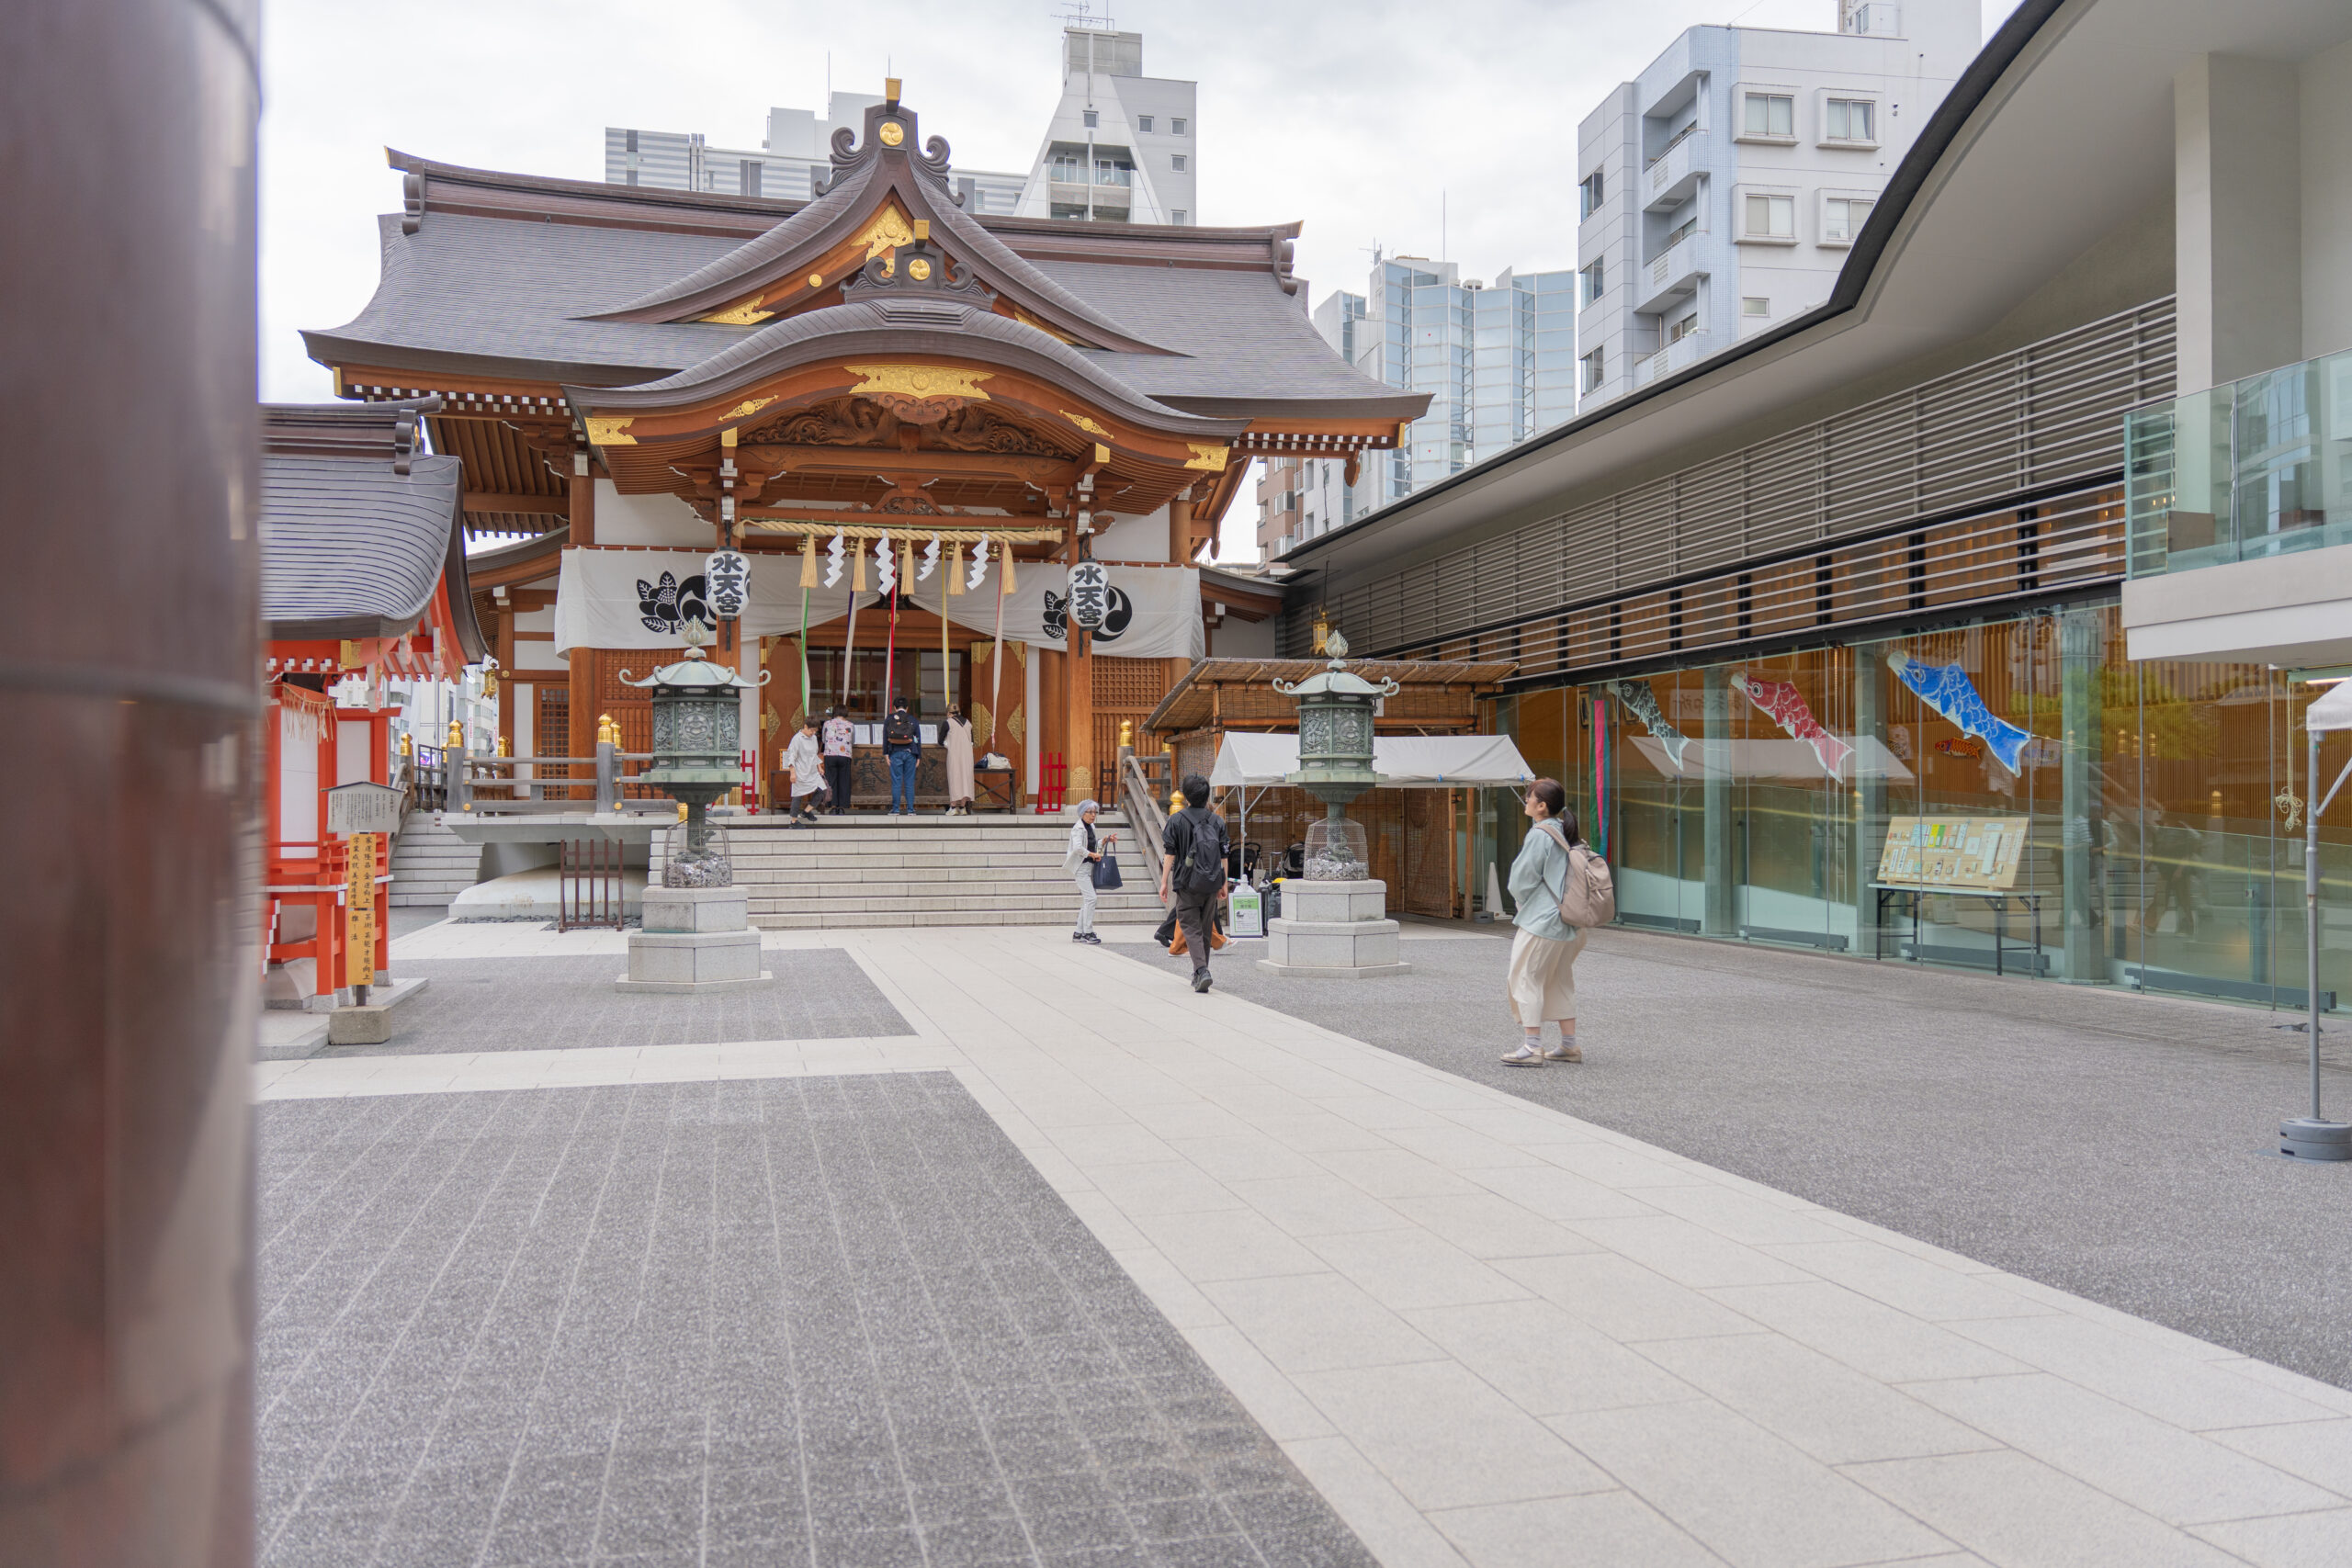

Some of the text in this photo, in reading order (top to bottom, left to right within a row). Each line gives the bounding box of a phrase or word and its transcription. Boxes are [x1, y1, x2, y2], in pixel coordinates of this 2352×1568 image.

[712, 553, 743, 614] 水天宮
[1074, 565, 1103, 625] 水天宮
